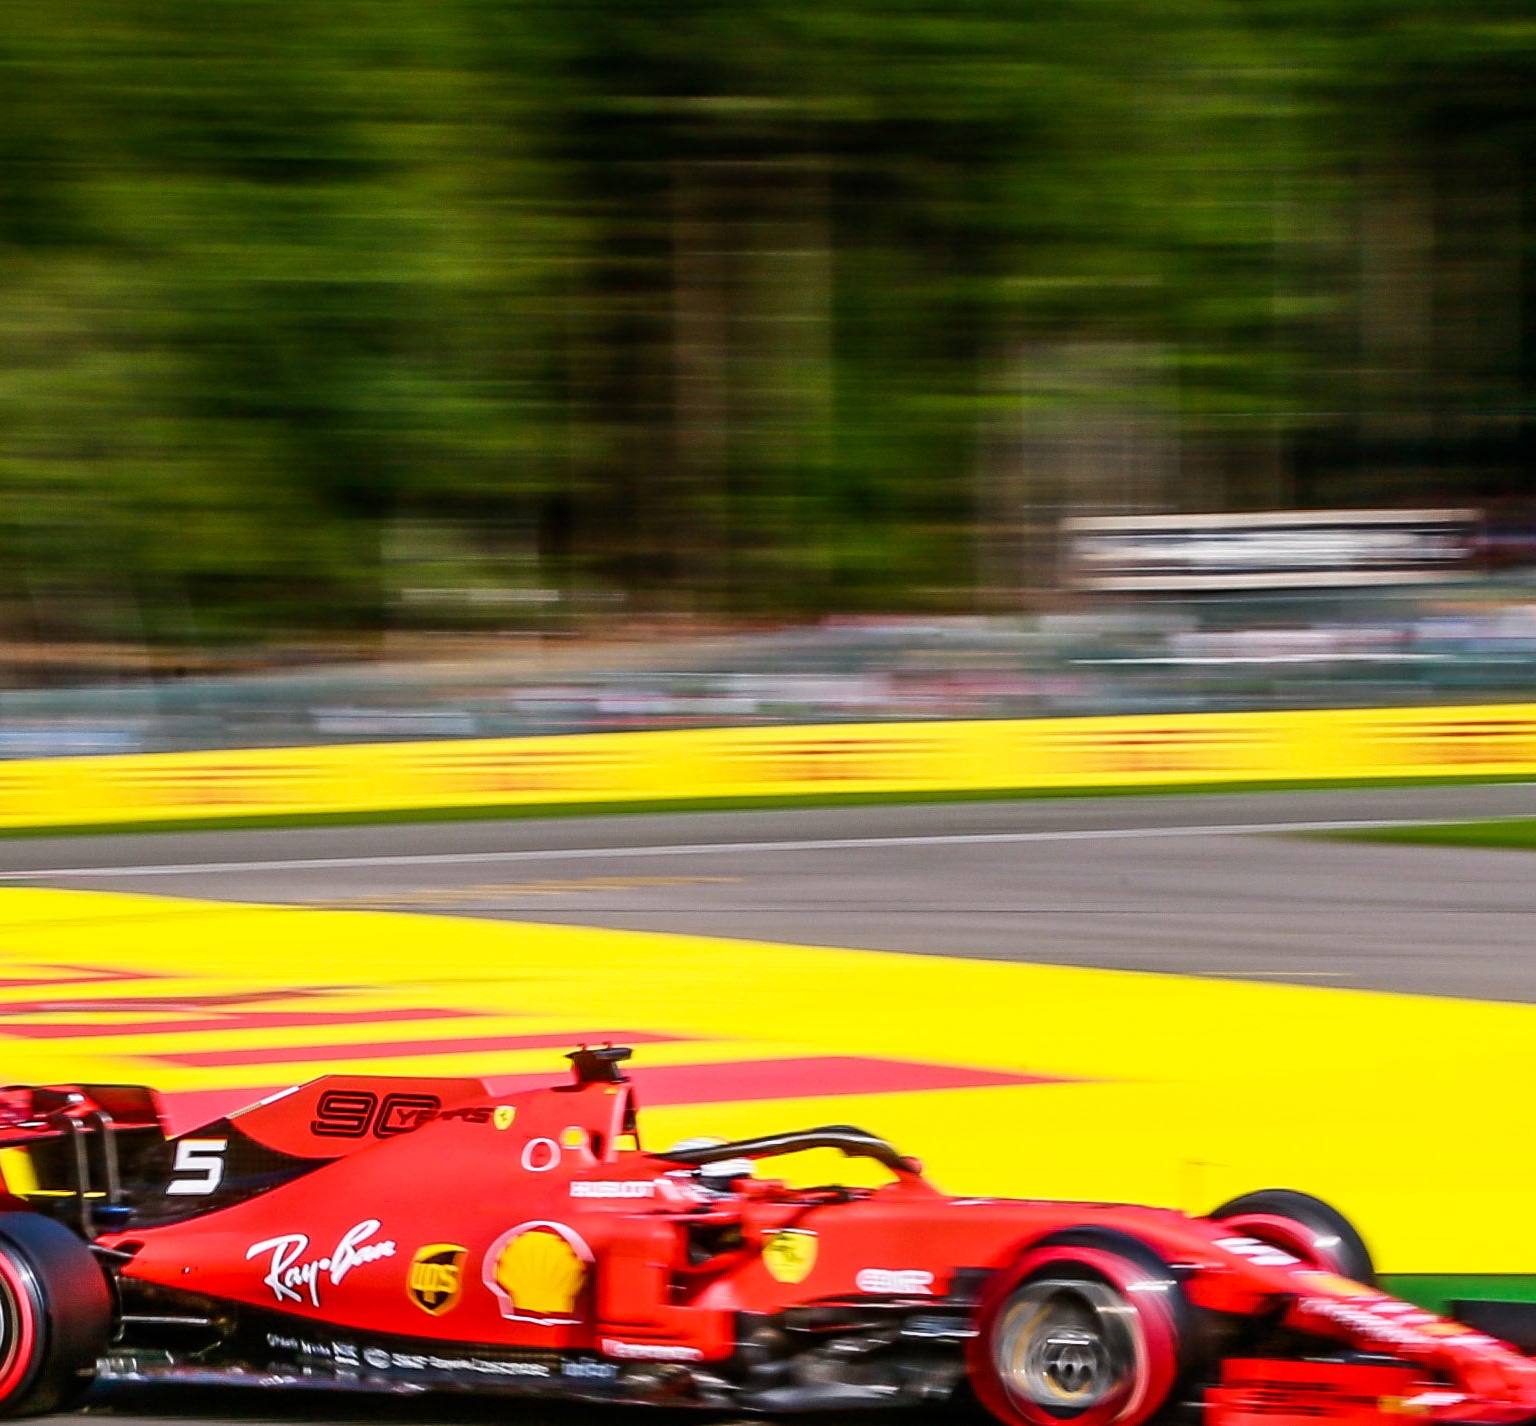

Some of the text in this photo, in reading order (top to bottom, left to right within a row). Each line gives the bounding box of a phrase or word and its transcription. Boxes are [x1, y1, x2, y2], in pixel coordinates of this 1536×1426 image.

[311, 1090, 441, 1139] 90
[166, 1138, 227, 1195] 5
[245, 1219, 397, 1307] Ray-Ban
